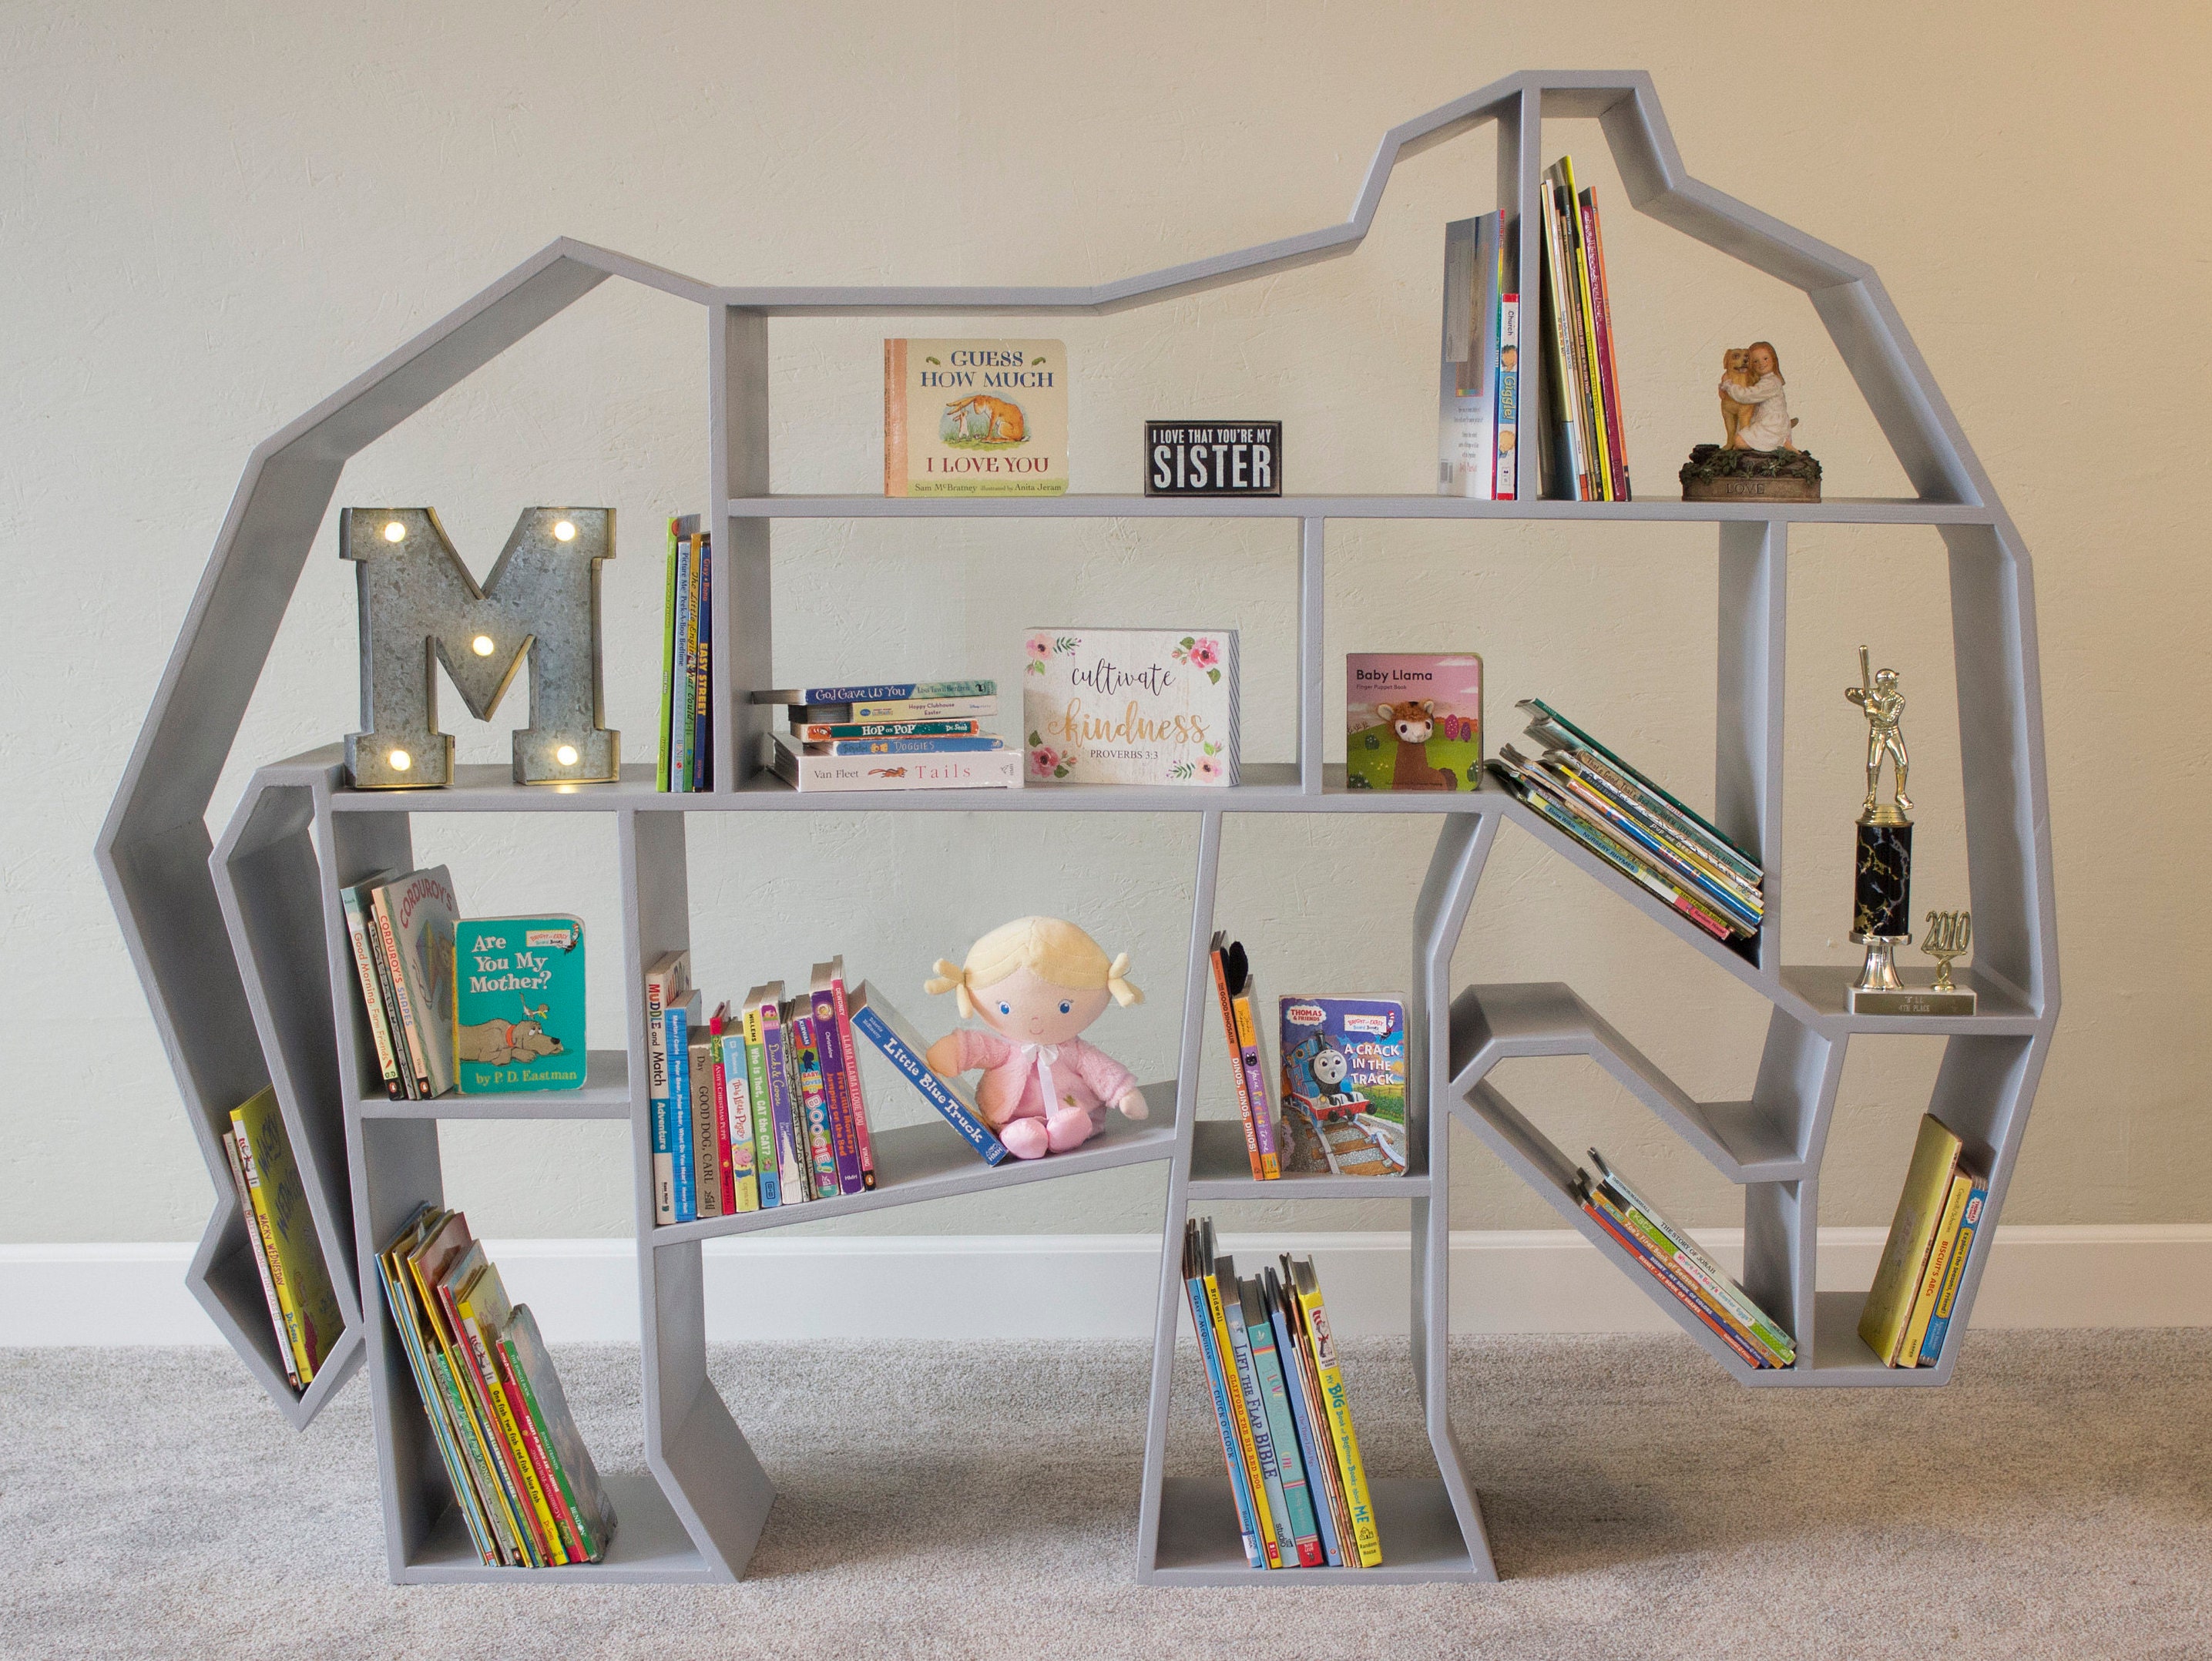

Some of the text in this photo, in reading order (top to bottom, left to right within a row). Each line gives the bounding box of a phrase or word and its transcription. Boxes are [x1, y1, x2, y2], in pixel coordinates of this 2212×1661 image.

[951, 351, 1023, 367] GUESS
[921, 371, 1054, 388] HOW MUCH
[1499, 375, 1516, 419] Giggle!
[1153, 429, 1271, 443] I LOVE THAT YOU'RE MY
[926, 458, 1049, 472] I LOVE YOU
[1154, 445, 1271, 488] SISTER
[935, 483, 977, 493] McBratney
[1727, 484, 1764, 495] LOVE
[340, 507, 620, 788] M
[696, 643, 709, 716] EASY STREET
[1072, 658, 1176, 696] cultivate
[1356, 669, 1432, 683] Baby Llama
[815, 686, 905, 701] God Gave Us You
[861, 725, 884, 736] HOP
[895, 724, 915, 735] POP
[1048, 698, 1211, 747] kindness
[893, 741, 935, 752] DOGGIES
[1090, 750, 1158, 760] PROVERBS 3:3
[814, 769, 860, 780] Van Fleet
[915, 765, 971, 780] Tails
[1582, 831, 1610, 853] NURSERY
[1609, 851, 1635, 871] RHYMES
[401, 878, 452, 929] CORDUROY'S
[1922, 911, 1971, 952] 2010
[472, 935, 507, 953] Are
[378, 914, 404, 984] CORDUROY'S
[395, 986, 413, 1026] SHAPES
[475, 951, 549, 972] You My
[469, 970, 552, 993] Mother?
[352, 931, 391, 1060] Good Morning, Farm Friends
[835, 987, 844, 1015] DEWDNEY
[747, 1013, 757, 1042] WILLEMS
[797, 1019, 810, 1045] KIRWAN
[750, 1047, 760, 1064] Who
[824, 1031, 833, 1059] Christelow
[841, 1034, 853, 1060] LLAMA
[1344, 1043, 1400, 1056] A CRACK
[846, 1061, 858, 1087] LLAMA
[1353, 1059, 1391, 1071] IN THE
[731, 1079, 743, 1096] This
[753, 1076, 764, 1097] That,
[1351, 1072, 1395, 1085] TRACK
[881, 1036, 986, 1144] Little Blue Truck
[717, 1086, 725, 1121] CHRISTMAS
[733, 1095, 745, 1114] Little
[757, 1099, 767, 1115] CAT
[851, 1092, 861, 1110] LOVE
[695, 1055, 713, 1183] Day GOOD DOG, CARL
[824, 1072, 848, 1156] Jumping on the Bed
[836, 1071, 855, 1153] Five Little Monkeys
[854, 1110, 864, 1126] YOU
[733, 1114, 748, 1139] Piggy
[758, 1117, 768, 1132] the
[804, 1093, 834, 1175] BOOGIE!
[679, 1144, 685, 1153] Do
[760, 1134, 771, 1155] CAT?
[987, 1146, 1003, 1161] HMH
[861, 1146, 871, 1166] VIKING
[257, 1212, 287, 1287] WACKY WEDNESDAY
[1659, 1221, 1716, 1274] THE STORY OF JONAH
[1957, 1231, 1969, 1255] Explore
[1931, 1240, 1949, 1277] BISCUIT'S
[1953, 1255, 1962, 1266] the
[1925, 1277, 1937, 1297] ABCs
[1945, 1266, 1959, 1292] Seasons,
[1209, 1287, 1223, 1323] Bridwell
[1938, 1291, 1951, 1314] Friend!
[491, 1390, 502, 1403] One
[496, 1403, 508, 1418] fish
[1232, 1343, 1279, 1480] LIFT THE FLAP BIBLE
[502, 1418, 514, 1432] two
[1229, 1374, 1261, 1489] CLIFFORD THE BIG RED DOG
[508, 1431, 519, 1446] fish
[514, 1448, 525, 1459] red
[519, 1459, 530, 1473] fish
[525, 1475, 536, 1490] blue
[531, 1489, 542, 1503] fish
[1274, 1522, 1288, 1548] studio
